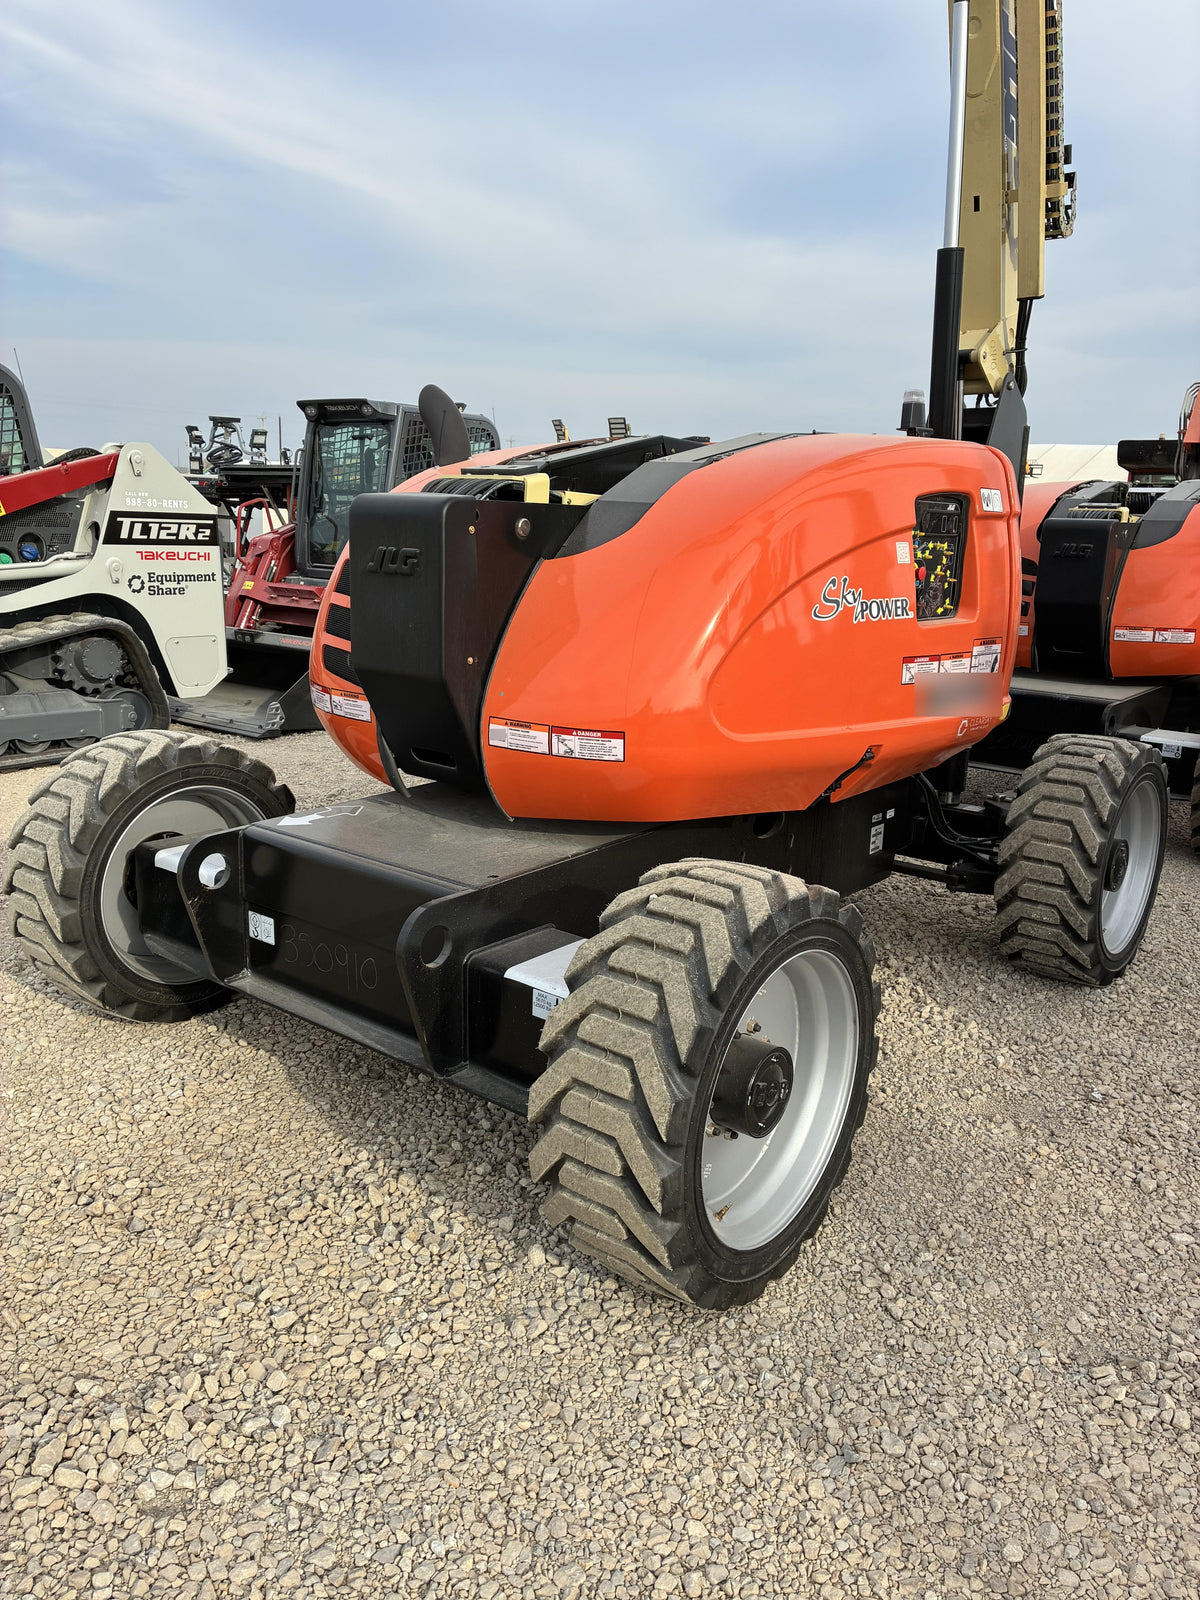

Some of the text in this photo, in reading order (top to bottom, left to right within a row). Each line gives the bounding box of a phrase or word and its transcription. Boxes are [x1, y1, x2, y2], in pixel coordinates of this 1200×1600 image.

[125, 497, 188, 509] 888-80-RENTS
[117, 517, 214, 540] TL12R2
[136, 550, 211, 561] TAKEUCHI
[367, 546, 420, 576] JLG
[147, 571, 217, 586] Equipment
[812, 576, 910, 623] Sky POWER
[577, 730, 602, 738] DANGER
[280, 923, 378, 993] 350910
